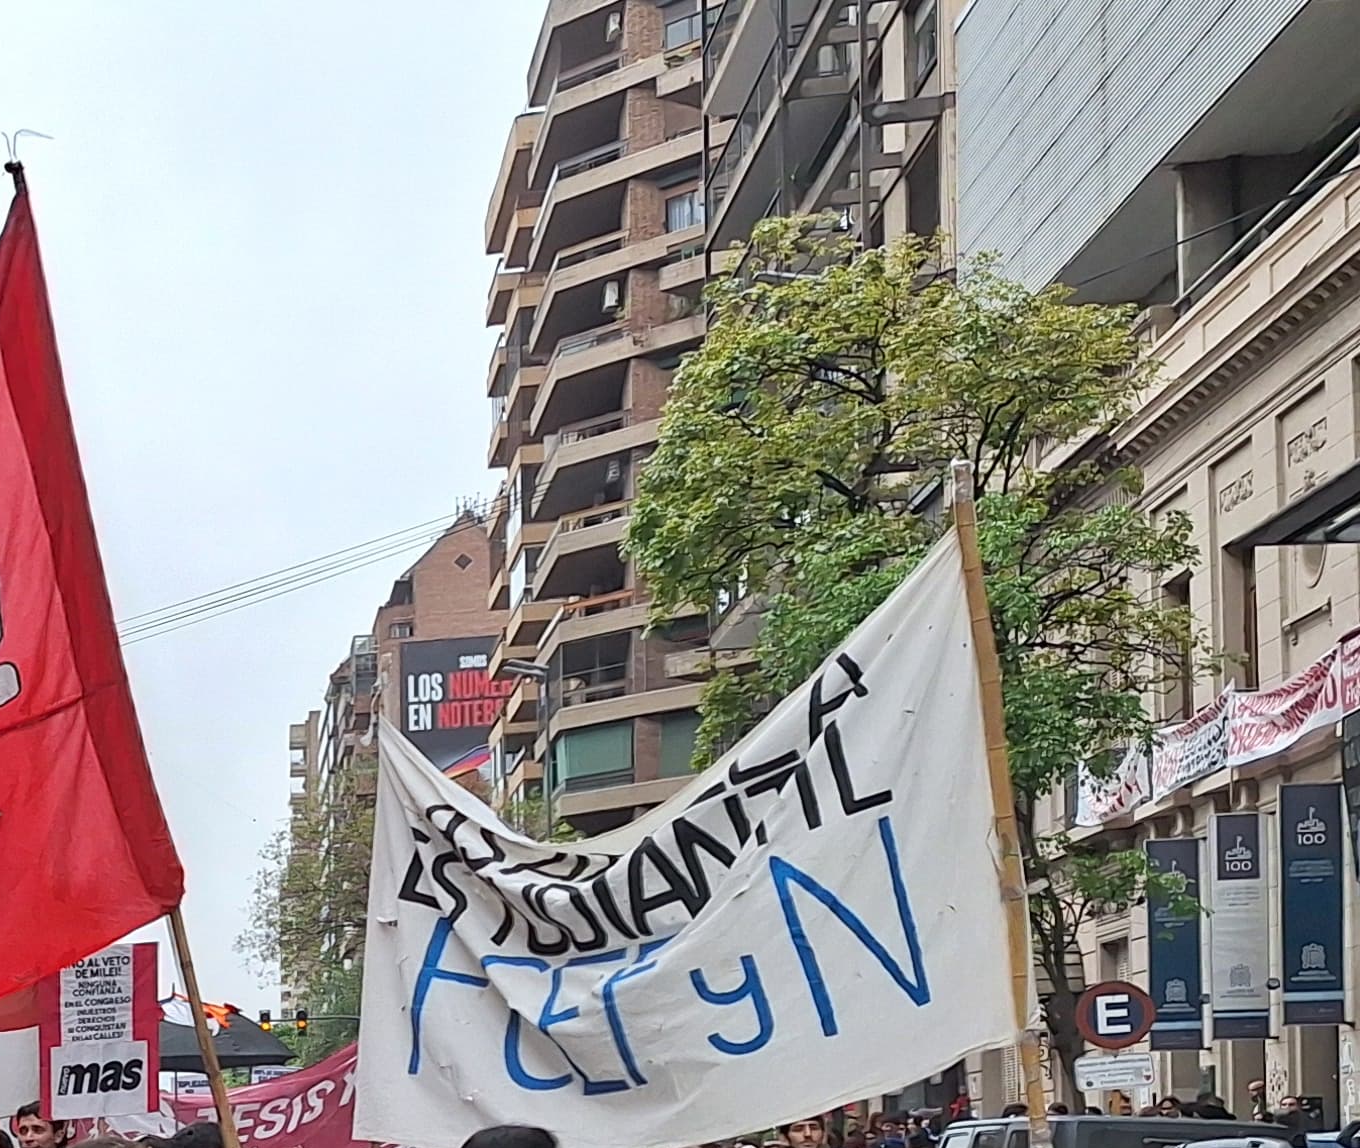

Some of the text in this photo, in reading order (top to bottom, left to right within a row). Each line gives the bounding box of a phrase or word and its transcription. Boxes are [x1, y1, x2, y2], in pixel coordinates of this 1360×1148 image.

[407, 672, 443, 703] LOS
[408, 703, 432, 731] EN
[1297, 833, 1326, 845] 100
[1225, 861, 1252, 872] 100
[87, 958, 100, 967] AL
[102, 956, 130, 966] VETO
[75, 967, 122, 978] DE MILEI!
[78, 980, 117, 988] NINGUNA
[72, 988, 122, 996] CONFIANZA
[84, 996, 131, 1006] CONGRESO
[1096, 994, 1131, 1035] E
[76, 1023, 126, 1033] CONQUISTAN
[70, 1058, 143, 1094] mas
